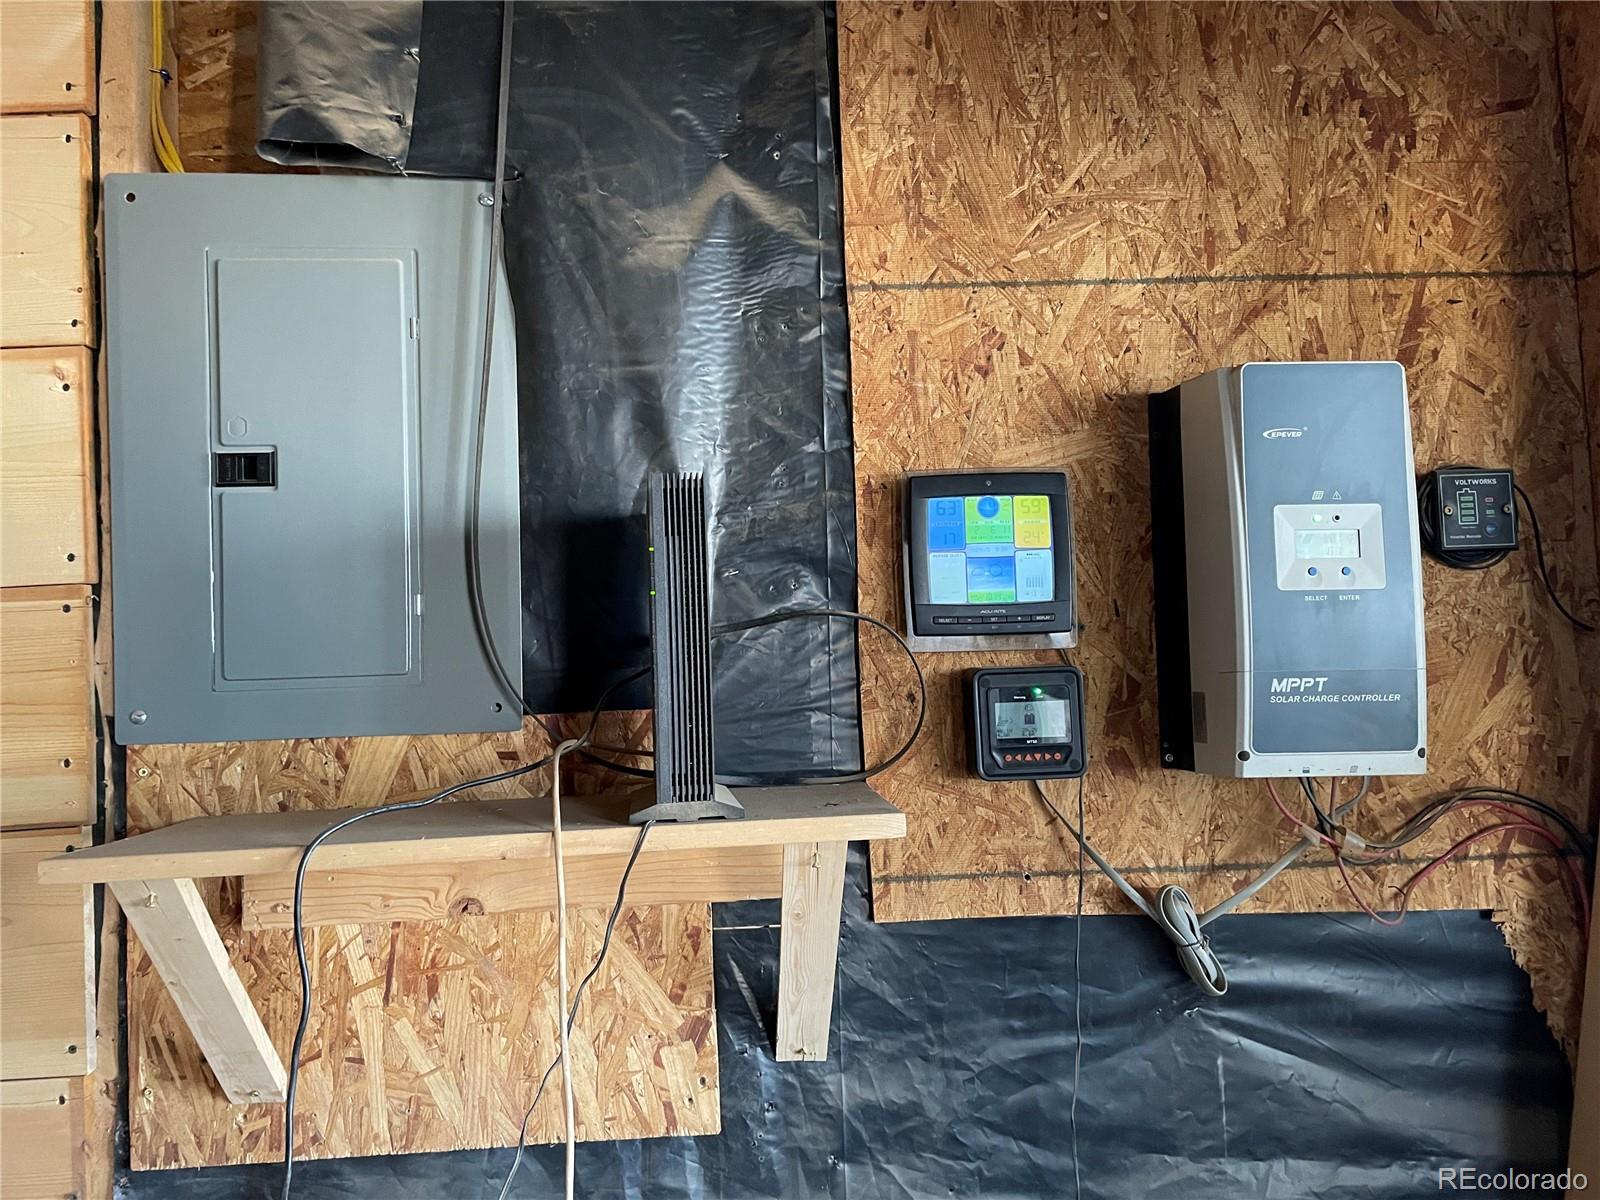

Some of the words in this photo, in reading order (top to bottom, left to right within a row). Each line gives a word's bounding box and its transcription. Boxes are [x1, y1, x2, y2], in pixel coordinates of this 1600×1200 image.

[1270, 677, 1329, 693] MPPT
[1269, 695, 1301, 703] SOLAR
[1302, 694, 1340, 702] CHARGE
[1341, 693, 1401, 702] CONTROLLER
